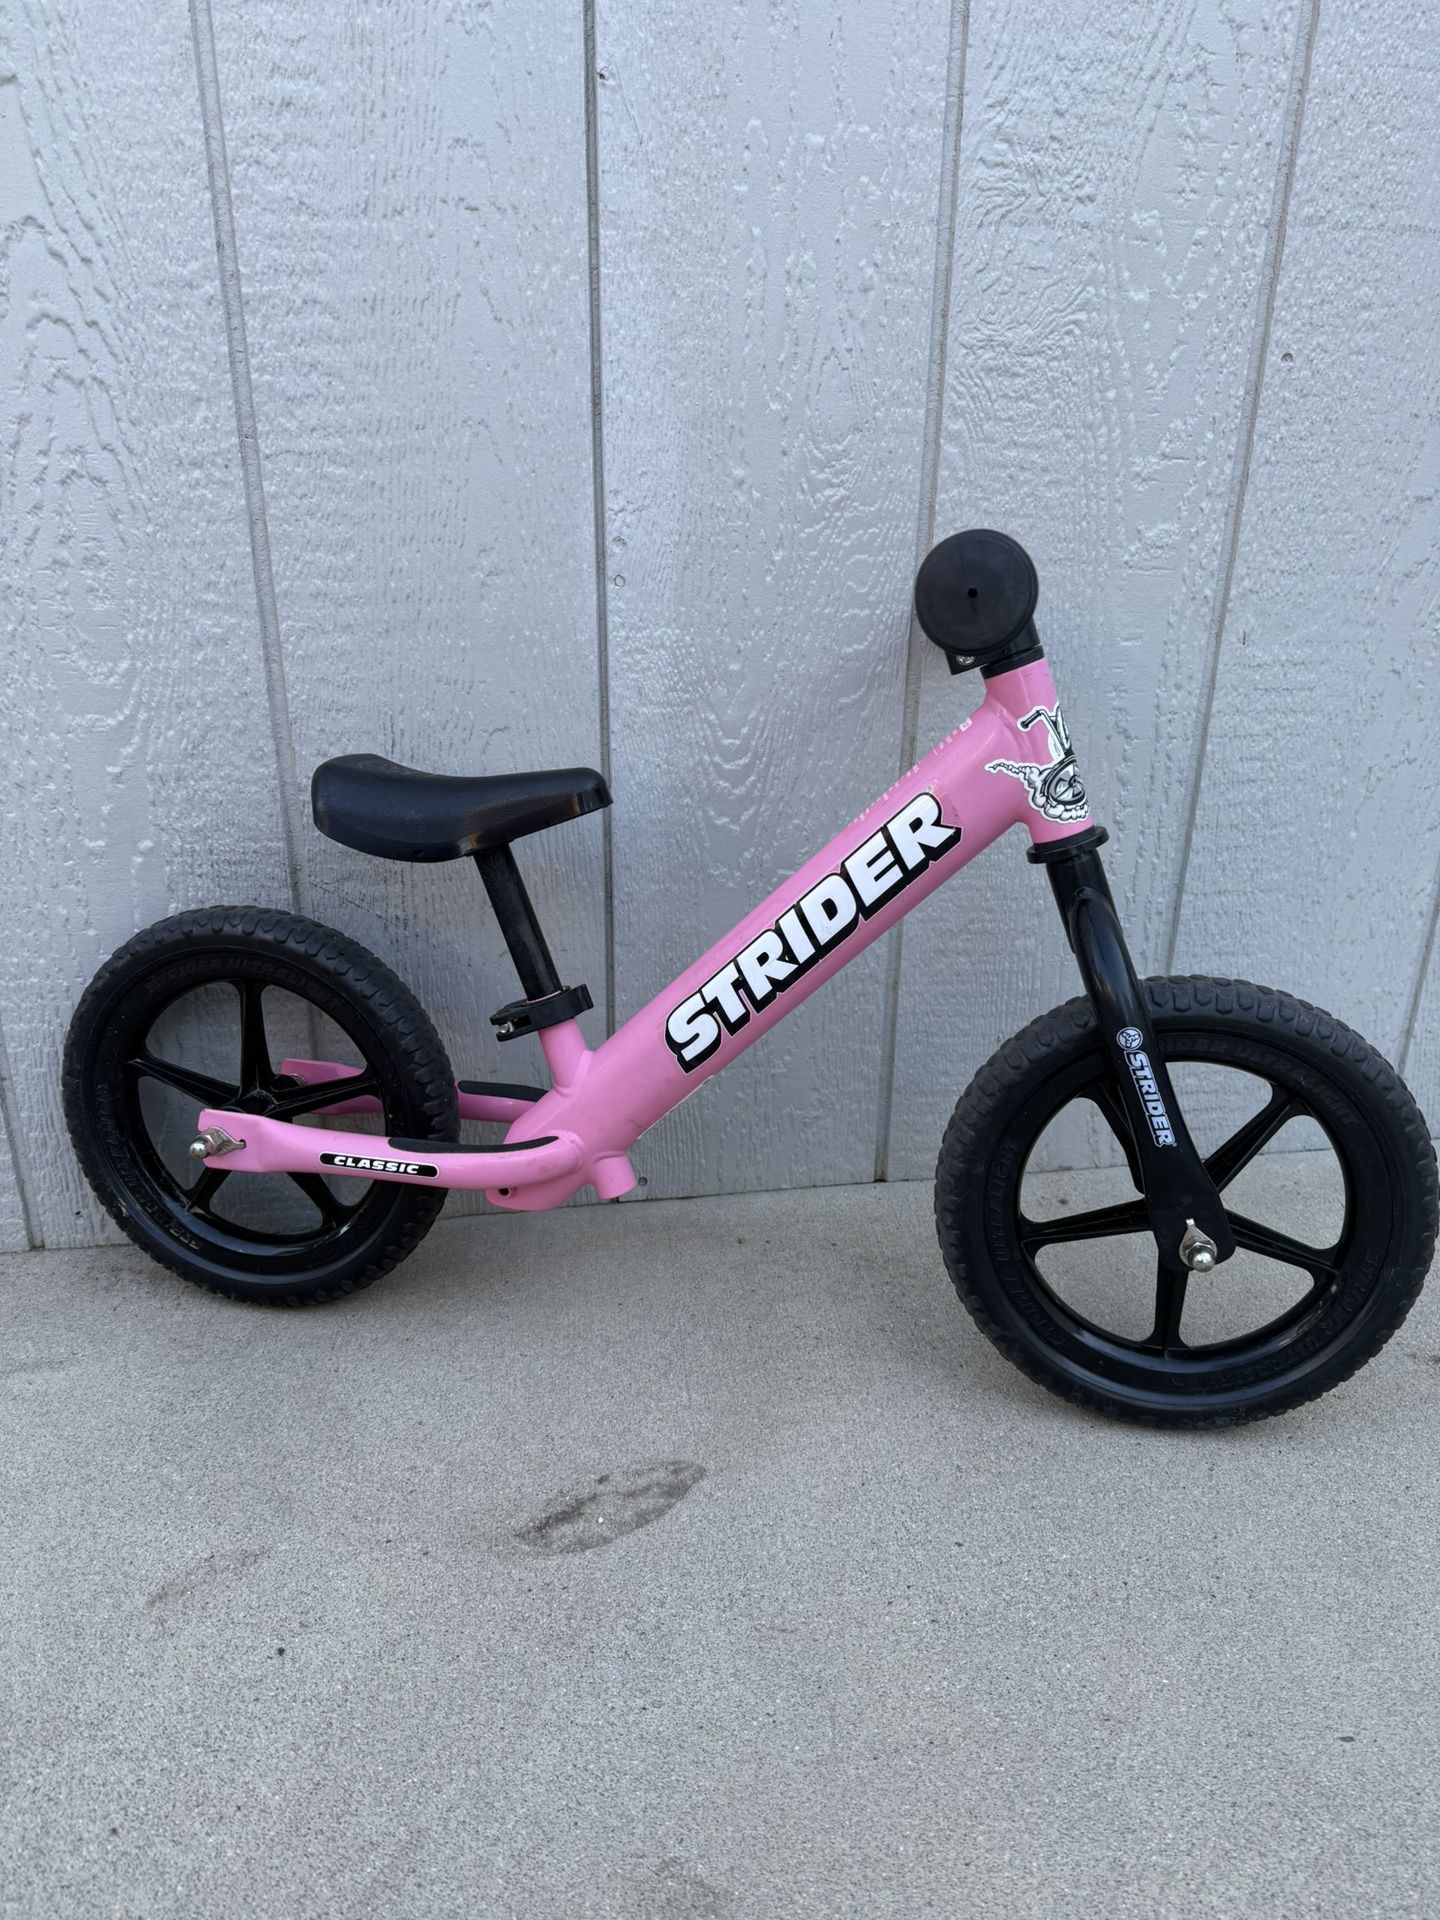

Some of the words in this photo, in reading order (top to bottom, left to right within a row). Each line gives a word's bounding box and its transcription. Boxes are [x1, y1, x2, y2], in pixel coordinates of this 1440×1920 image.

[666, 793, 960, 1071] STRIDER
[1126, 1051, 1175, 1147] STRIDER
[333, 1156, 419, 1174] CLASSIC
